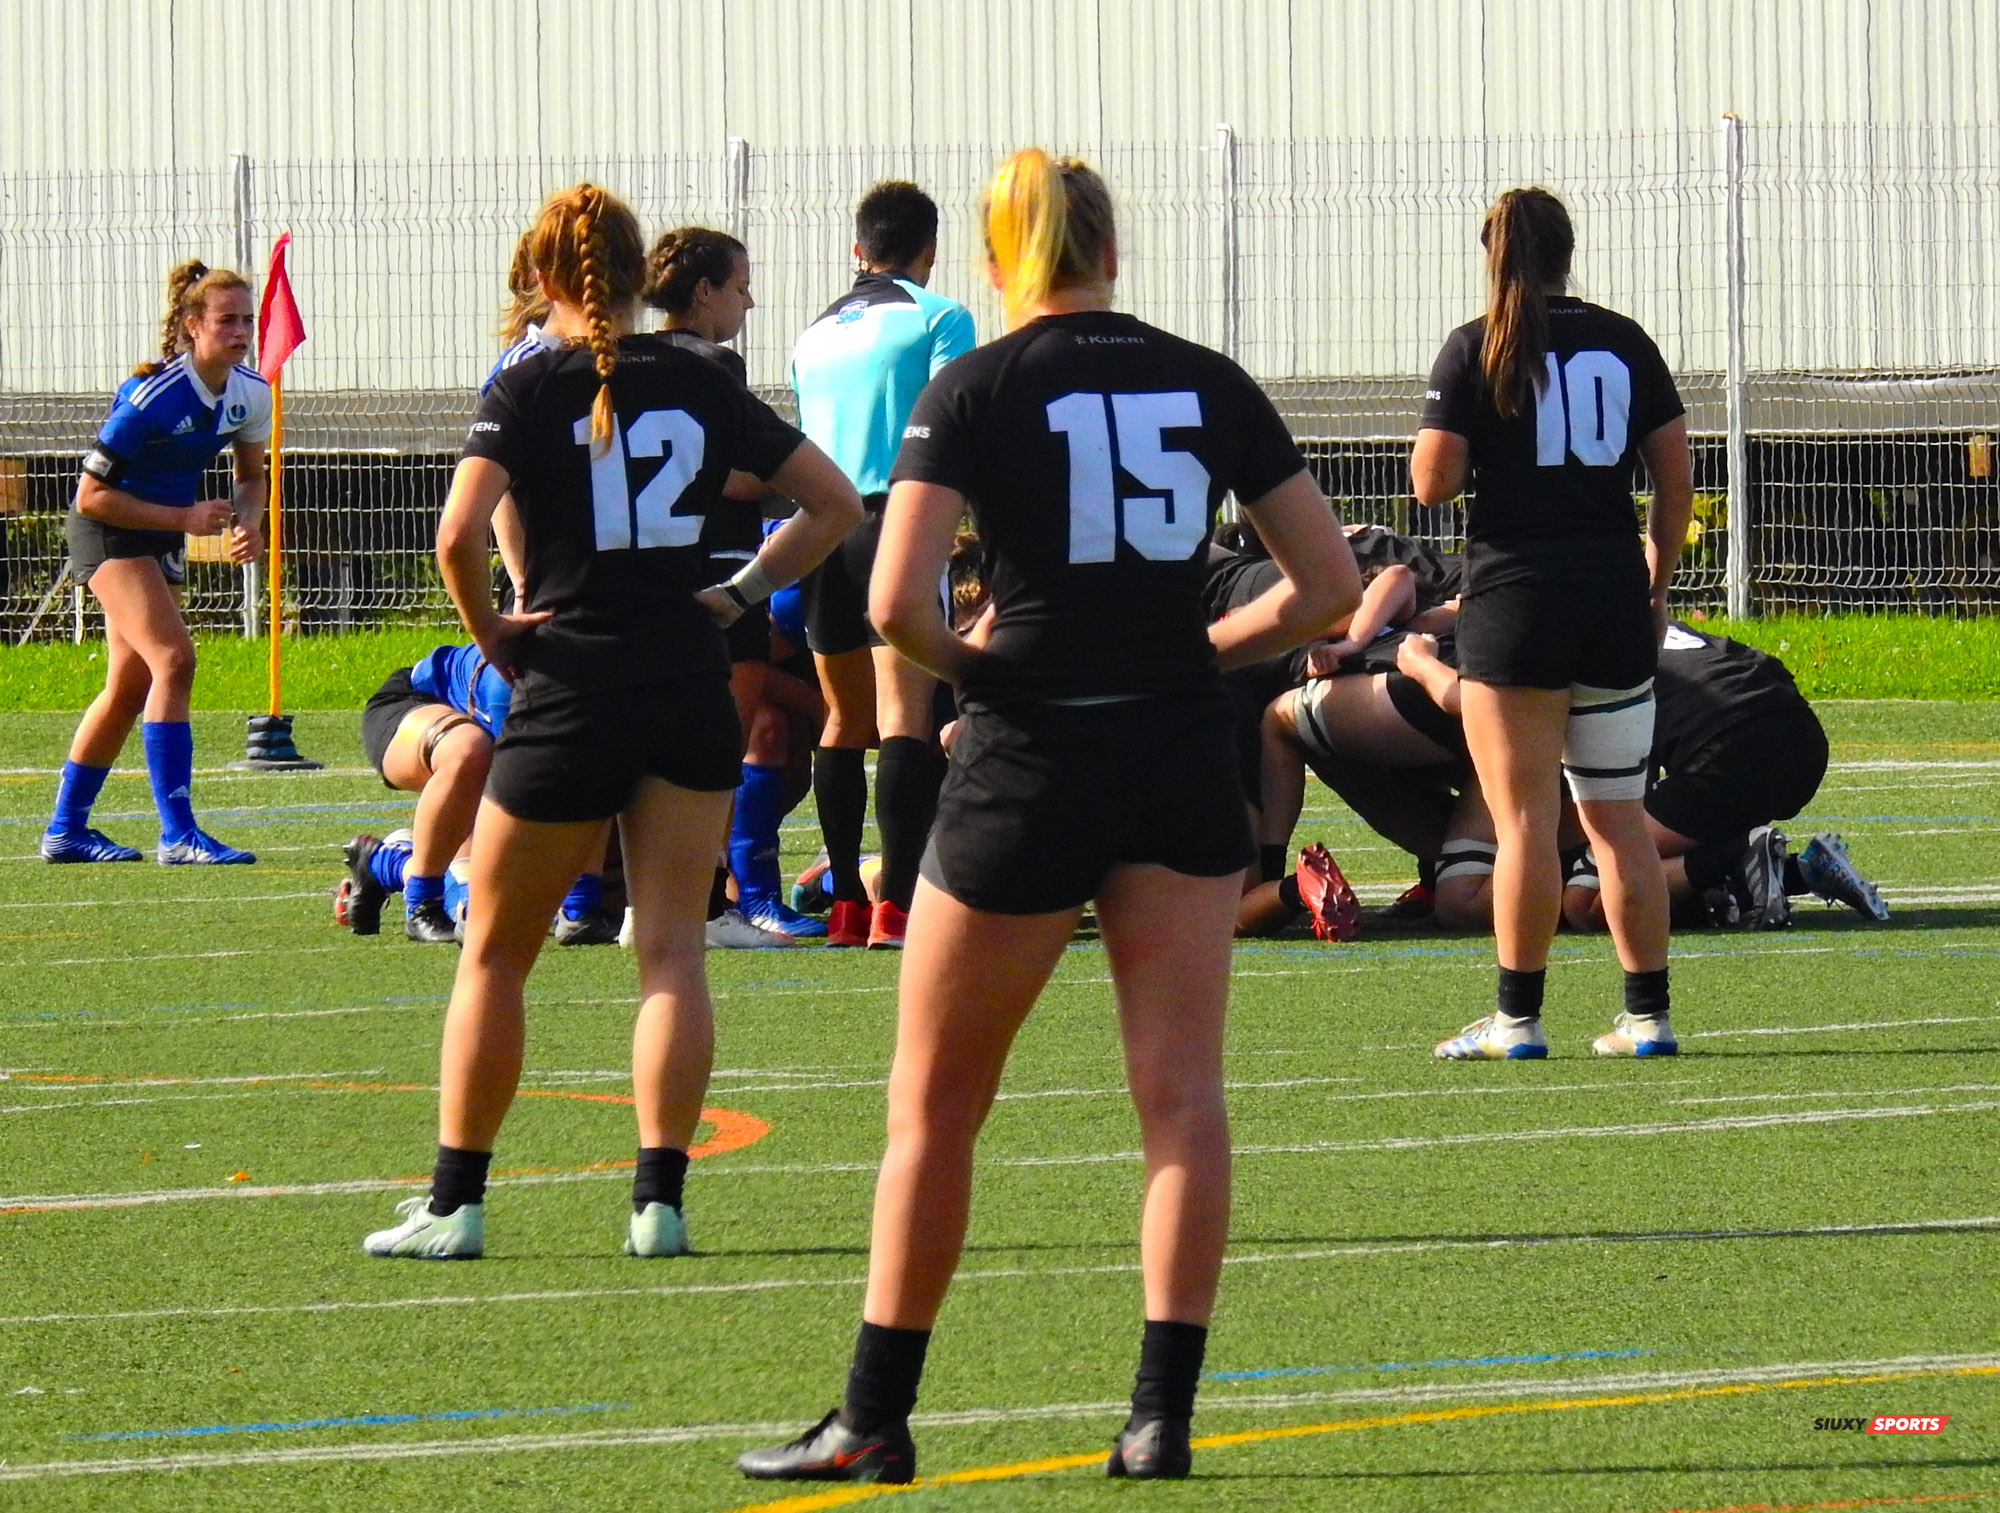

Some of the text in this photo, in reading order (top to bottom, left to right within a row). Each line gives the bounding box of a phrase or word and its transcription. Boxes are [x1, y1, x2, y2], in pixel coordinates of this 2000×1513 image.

[1088, 335, 1146, 344] KUKRI
[1531, 350, 1632, 467] 10
[573, 409, 706, 552] 12
[1045, 391, 1212, 564] 15
